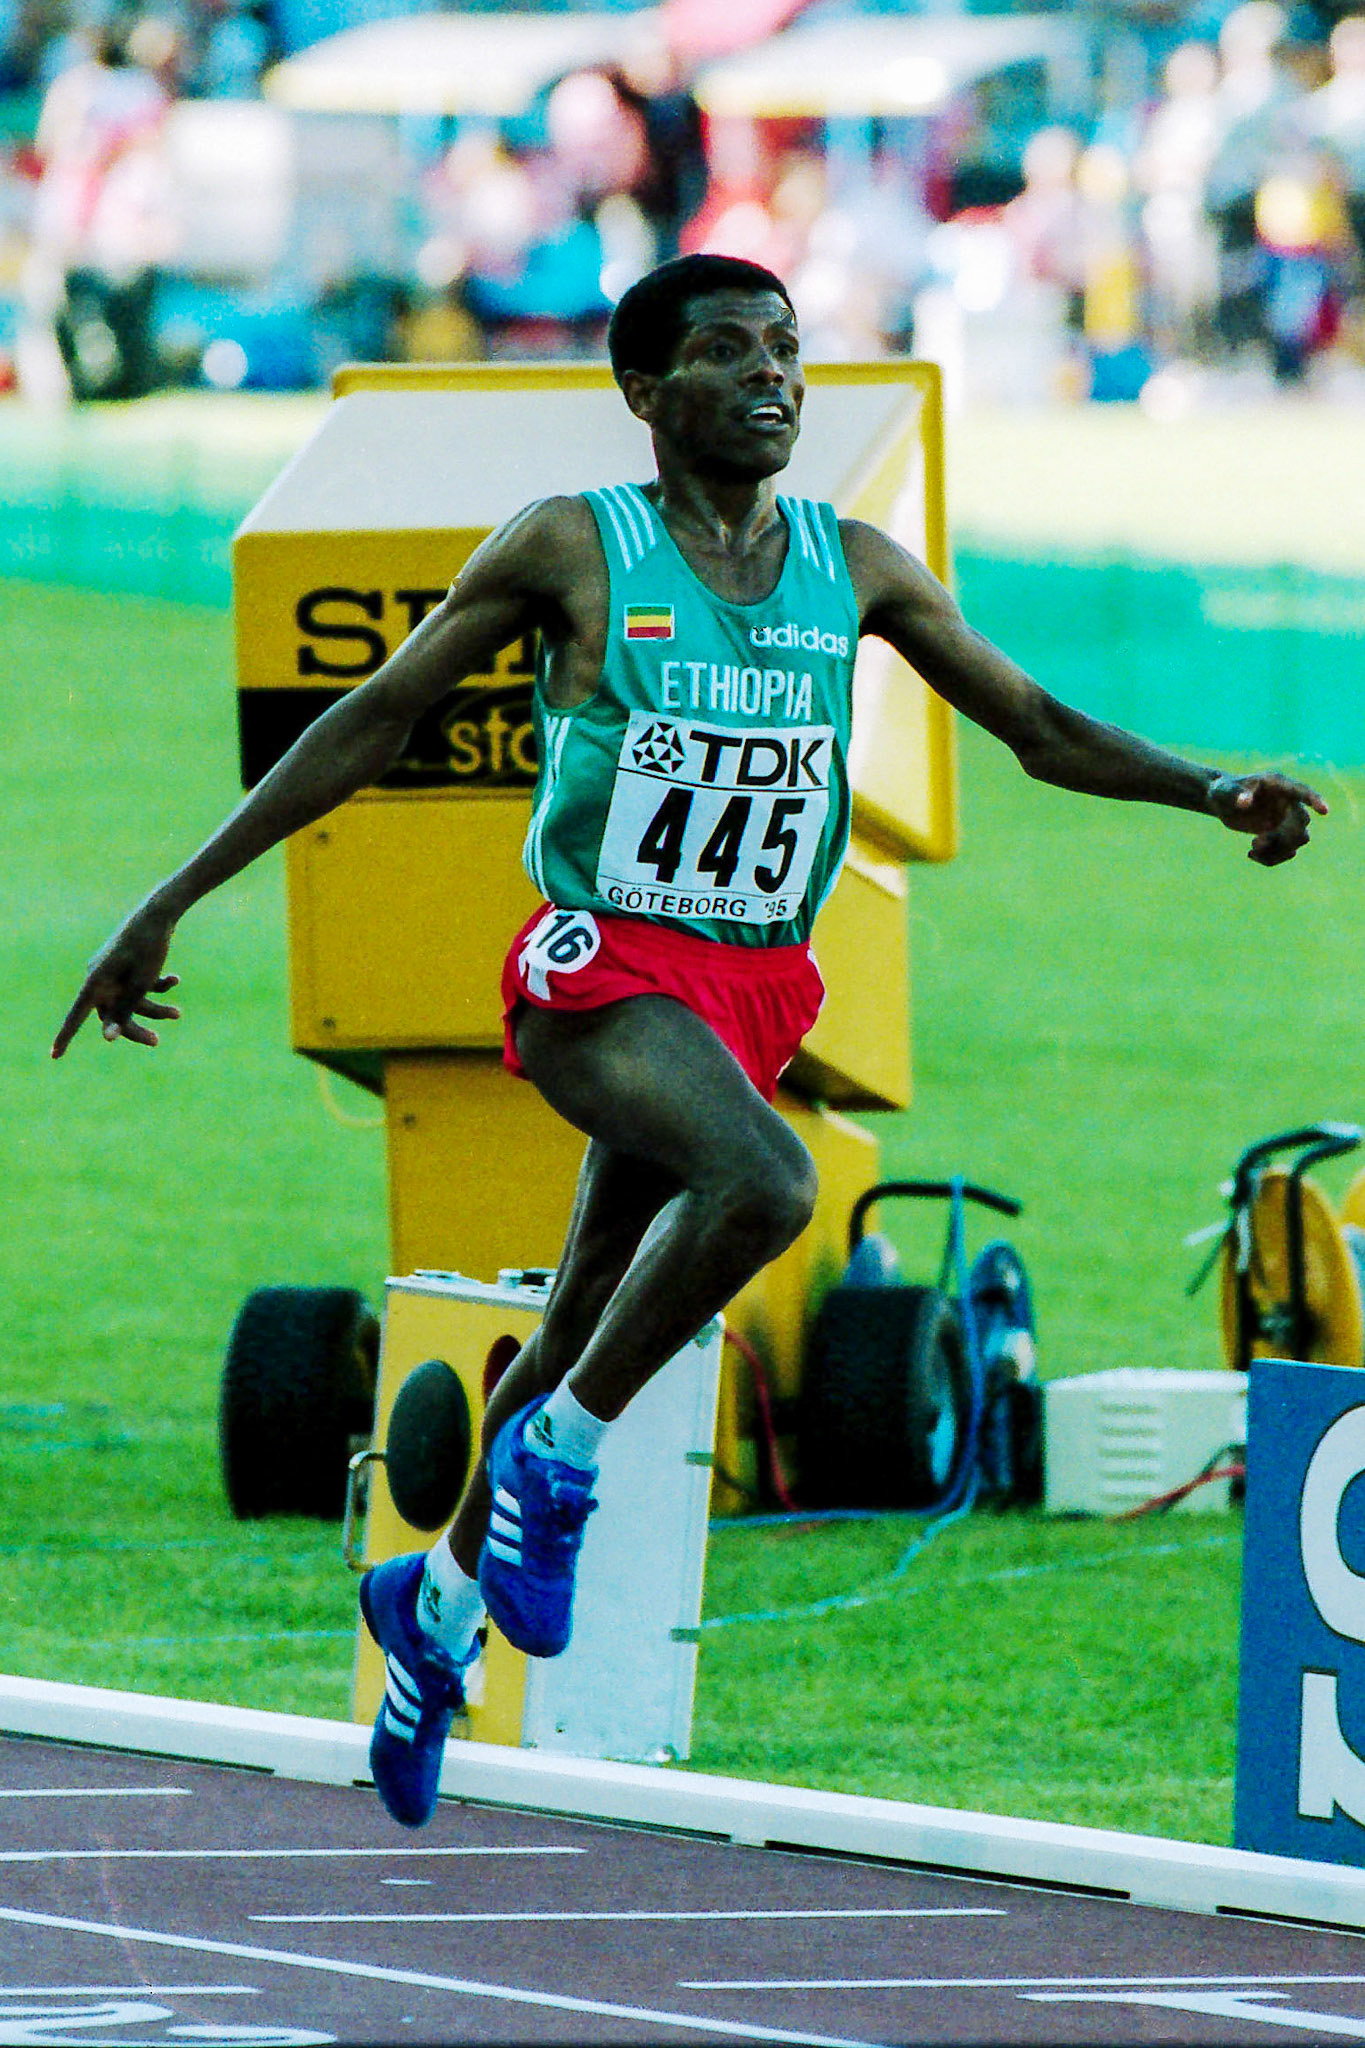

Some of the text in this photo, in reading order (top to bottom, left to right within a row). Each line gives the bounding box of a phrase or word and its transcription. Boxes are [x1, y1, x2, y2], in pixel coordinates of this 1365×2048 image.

[750, 623, 849, 658] adidas
[661, 660, 812, 721] ETHIOPIA
[689, 729, 825, 788] TDK
[637, 787, 806, 894] 445
[608, 886, 747, 917] GÖTEBORG
[536, 914, 593, 964] 16
